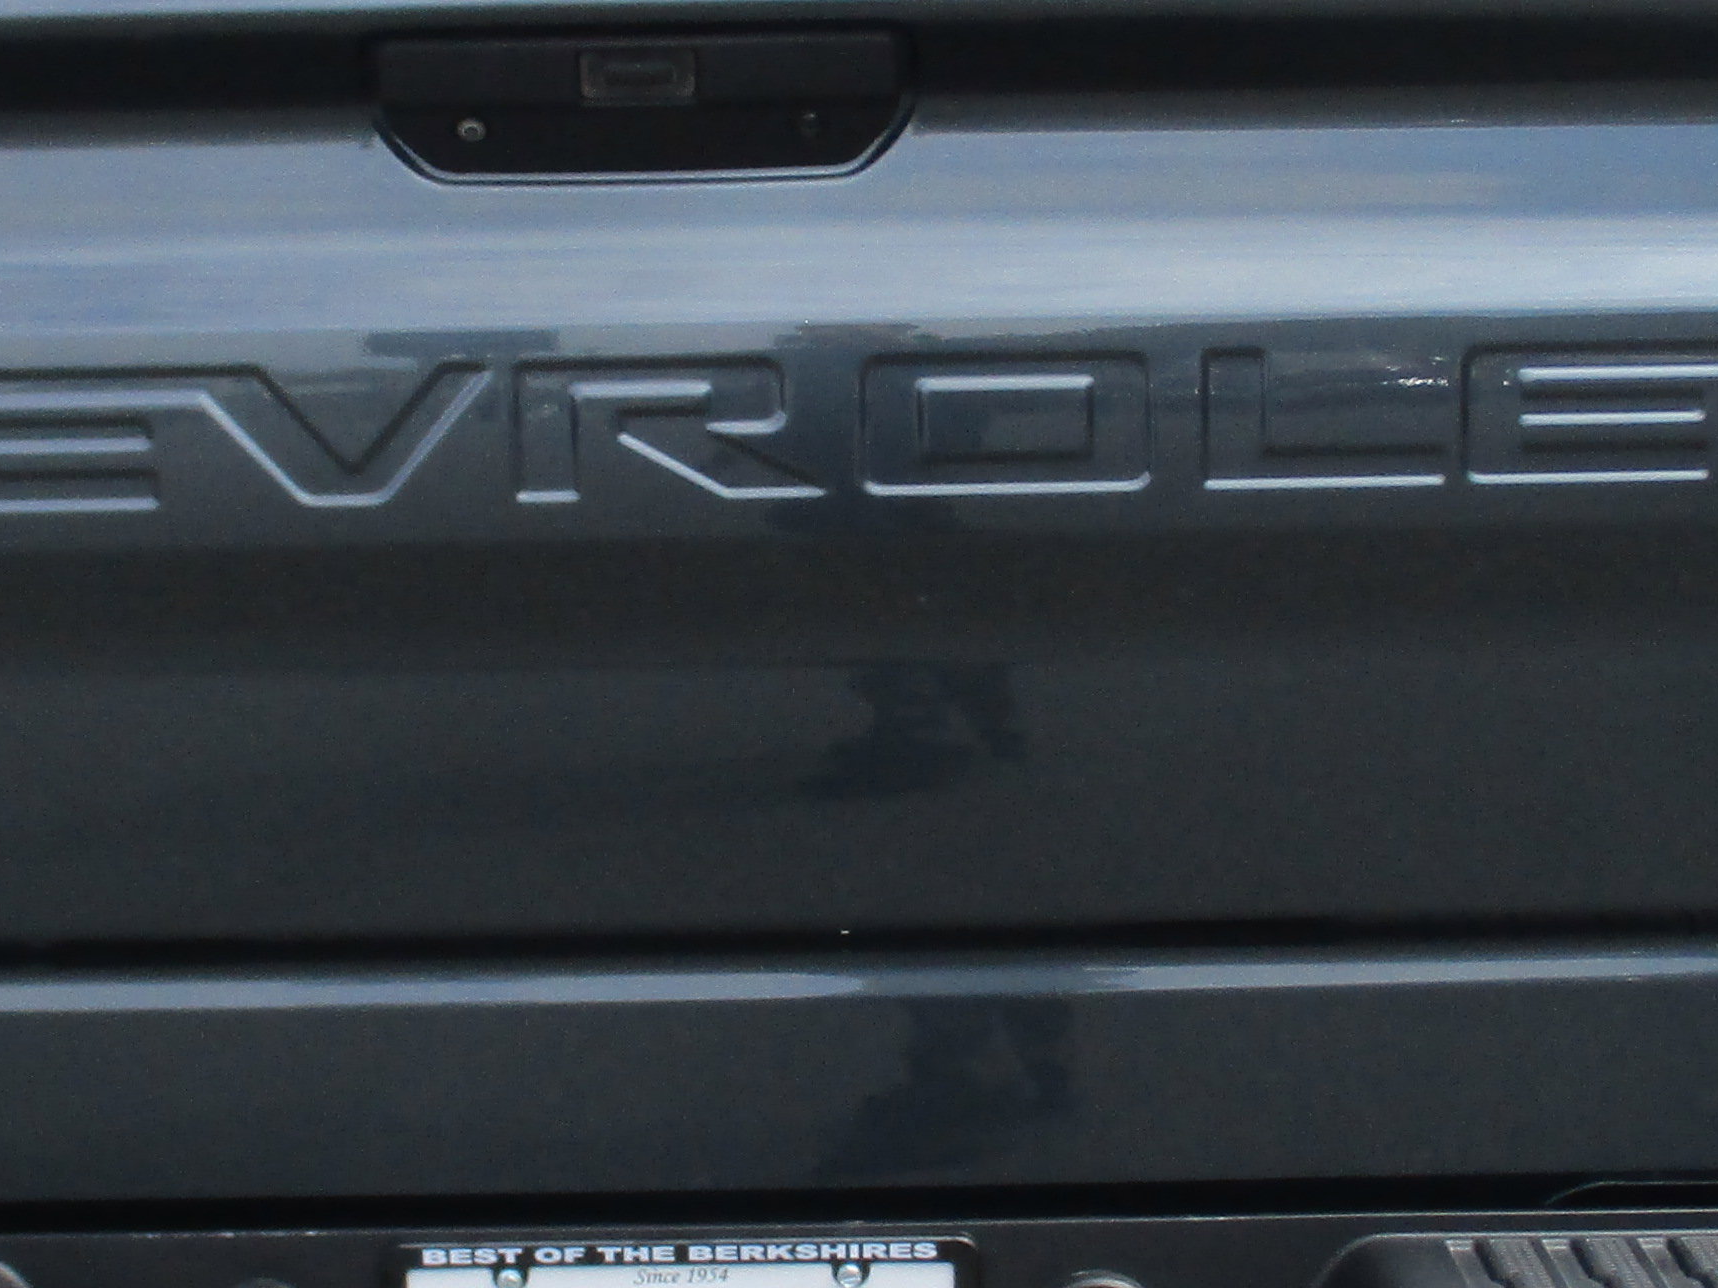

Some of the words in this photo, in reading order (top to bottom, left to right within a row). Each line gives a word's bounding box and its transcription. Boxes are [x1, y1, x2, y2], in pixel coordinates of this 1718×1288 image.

[421, 1248, 523, 1265] BEST
[534, 1247, 586, 1263] OF
[597, 1245, 676, 1262] THE
[688, 1242, 938, 1261] BERKSHIRES
[633, 1267, 681, 1285] Since
[686, 1266, 729, 1284] 1954
